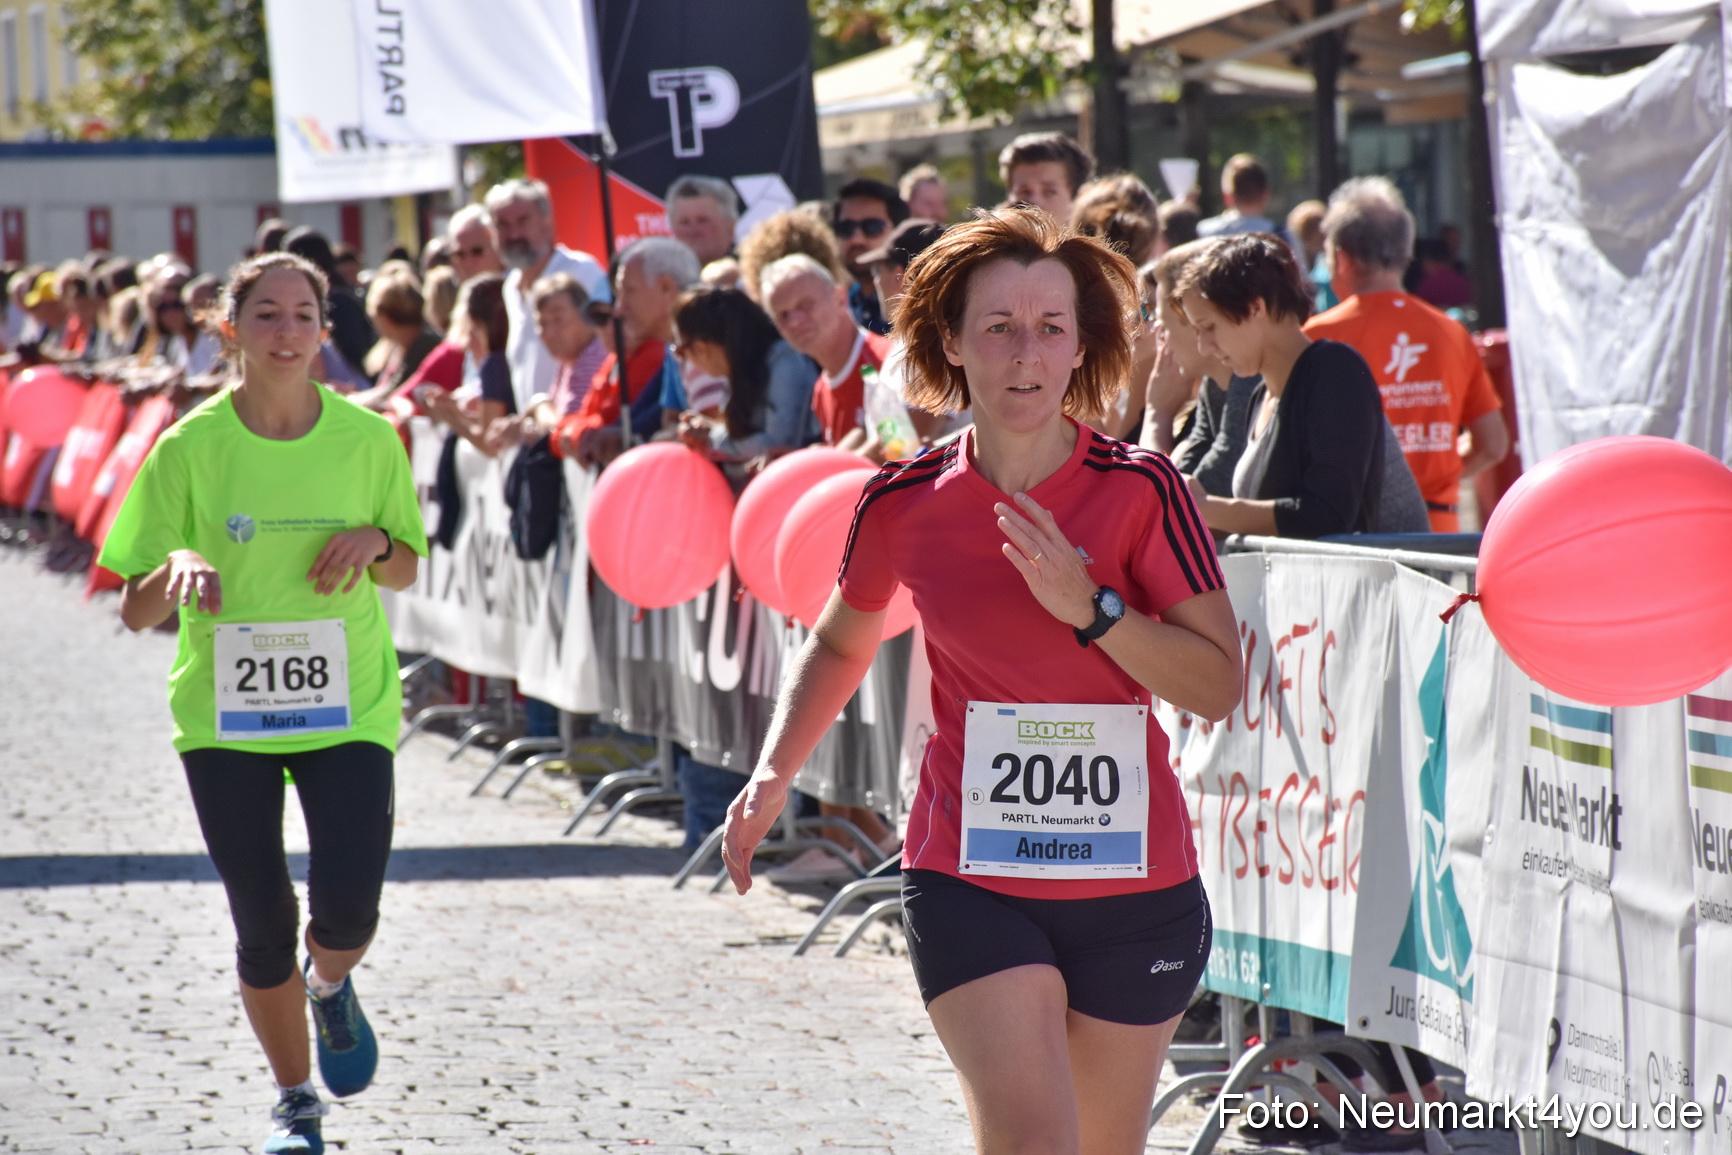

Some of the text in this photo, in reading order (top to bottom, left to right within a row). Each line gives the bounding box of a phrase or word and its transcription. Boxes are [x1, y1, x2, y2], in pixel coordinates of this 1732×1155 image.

[253, 634, 309, 647] BOCK
[236, 655, 329, 692] 2168
[274, 697, 311, 705] Neumarkt
[262, 714, 306, 728] Maria
[1018, 720, 1095, 739] BOCK
[1018, 739, 1041, 747] inspired
[990, 752, 1120, 806] 2040
[972, 792, 979, 801] D
[1002, 813, 1095, 825] PARTL Neumarkt
[1015, 837, 1092, 860] Andrea
[1385, 986, 1415, 1021] Jura
[1563, 1057, 1607, 1092] Neumarkt
